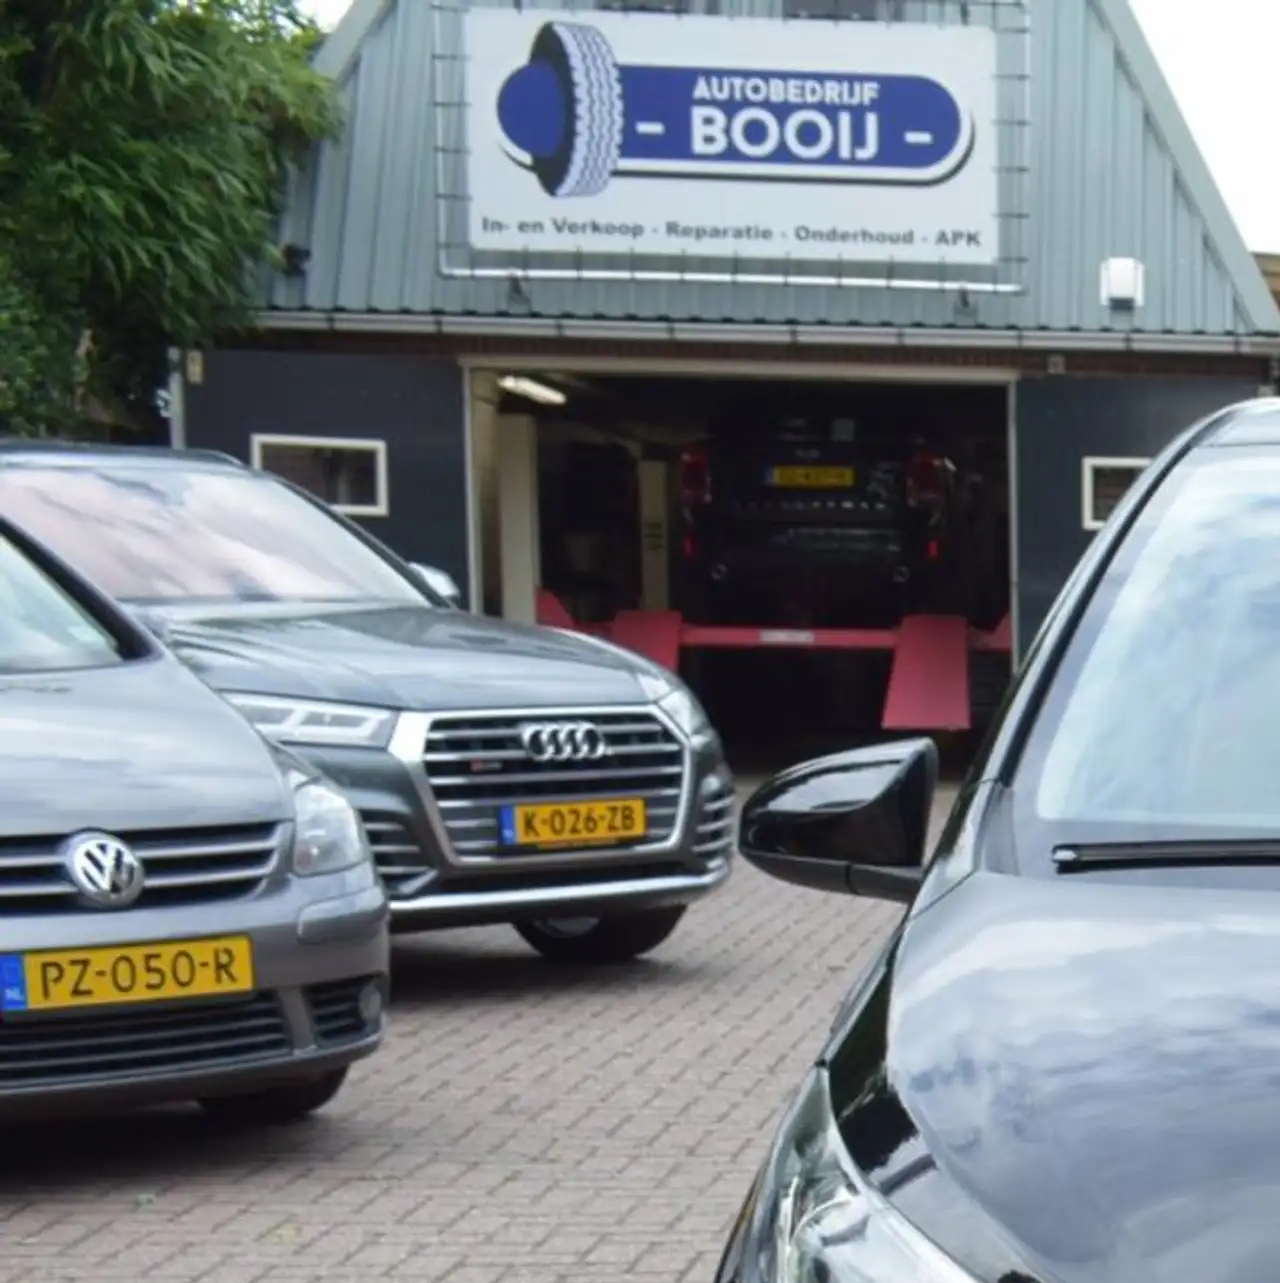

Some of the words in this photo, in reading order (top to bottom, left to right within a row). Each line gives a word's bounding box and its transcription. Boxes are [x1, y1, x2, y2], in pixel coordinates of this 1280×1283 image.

[692, 75, 880, 105] AUTOBEDRIJF
[690, 106, 879, 160] BOOIJ
[517, 220, 545, 234] en
[551, 217, 645, 239] Verkoop
[665, 220, 774, 242] Reparatie
[794, 225, 915, 245] Onderhoud
[935, 229, 982, 247] APK
[523, 805, 635, 838] K-026-ZB
[40, 947, 238, 1000] PZ-050-R
